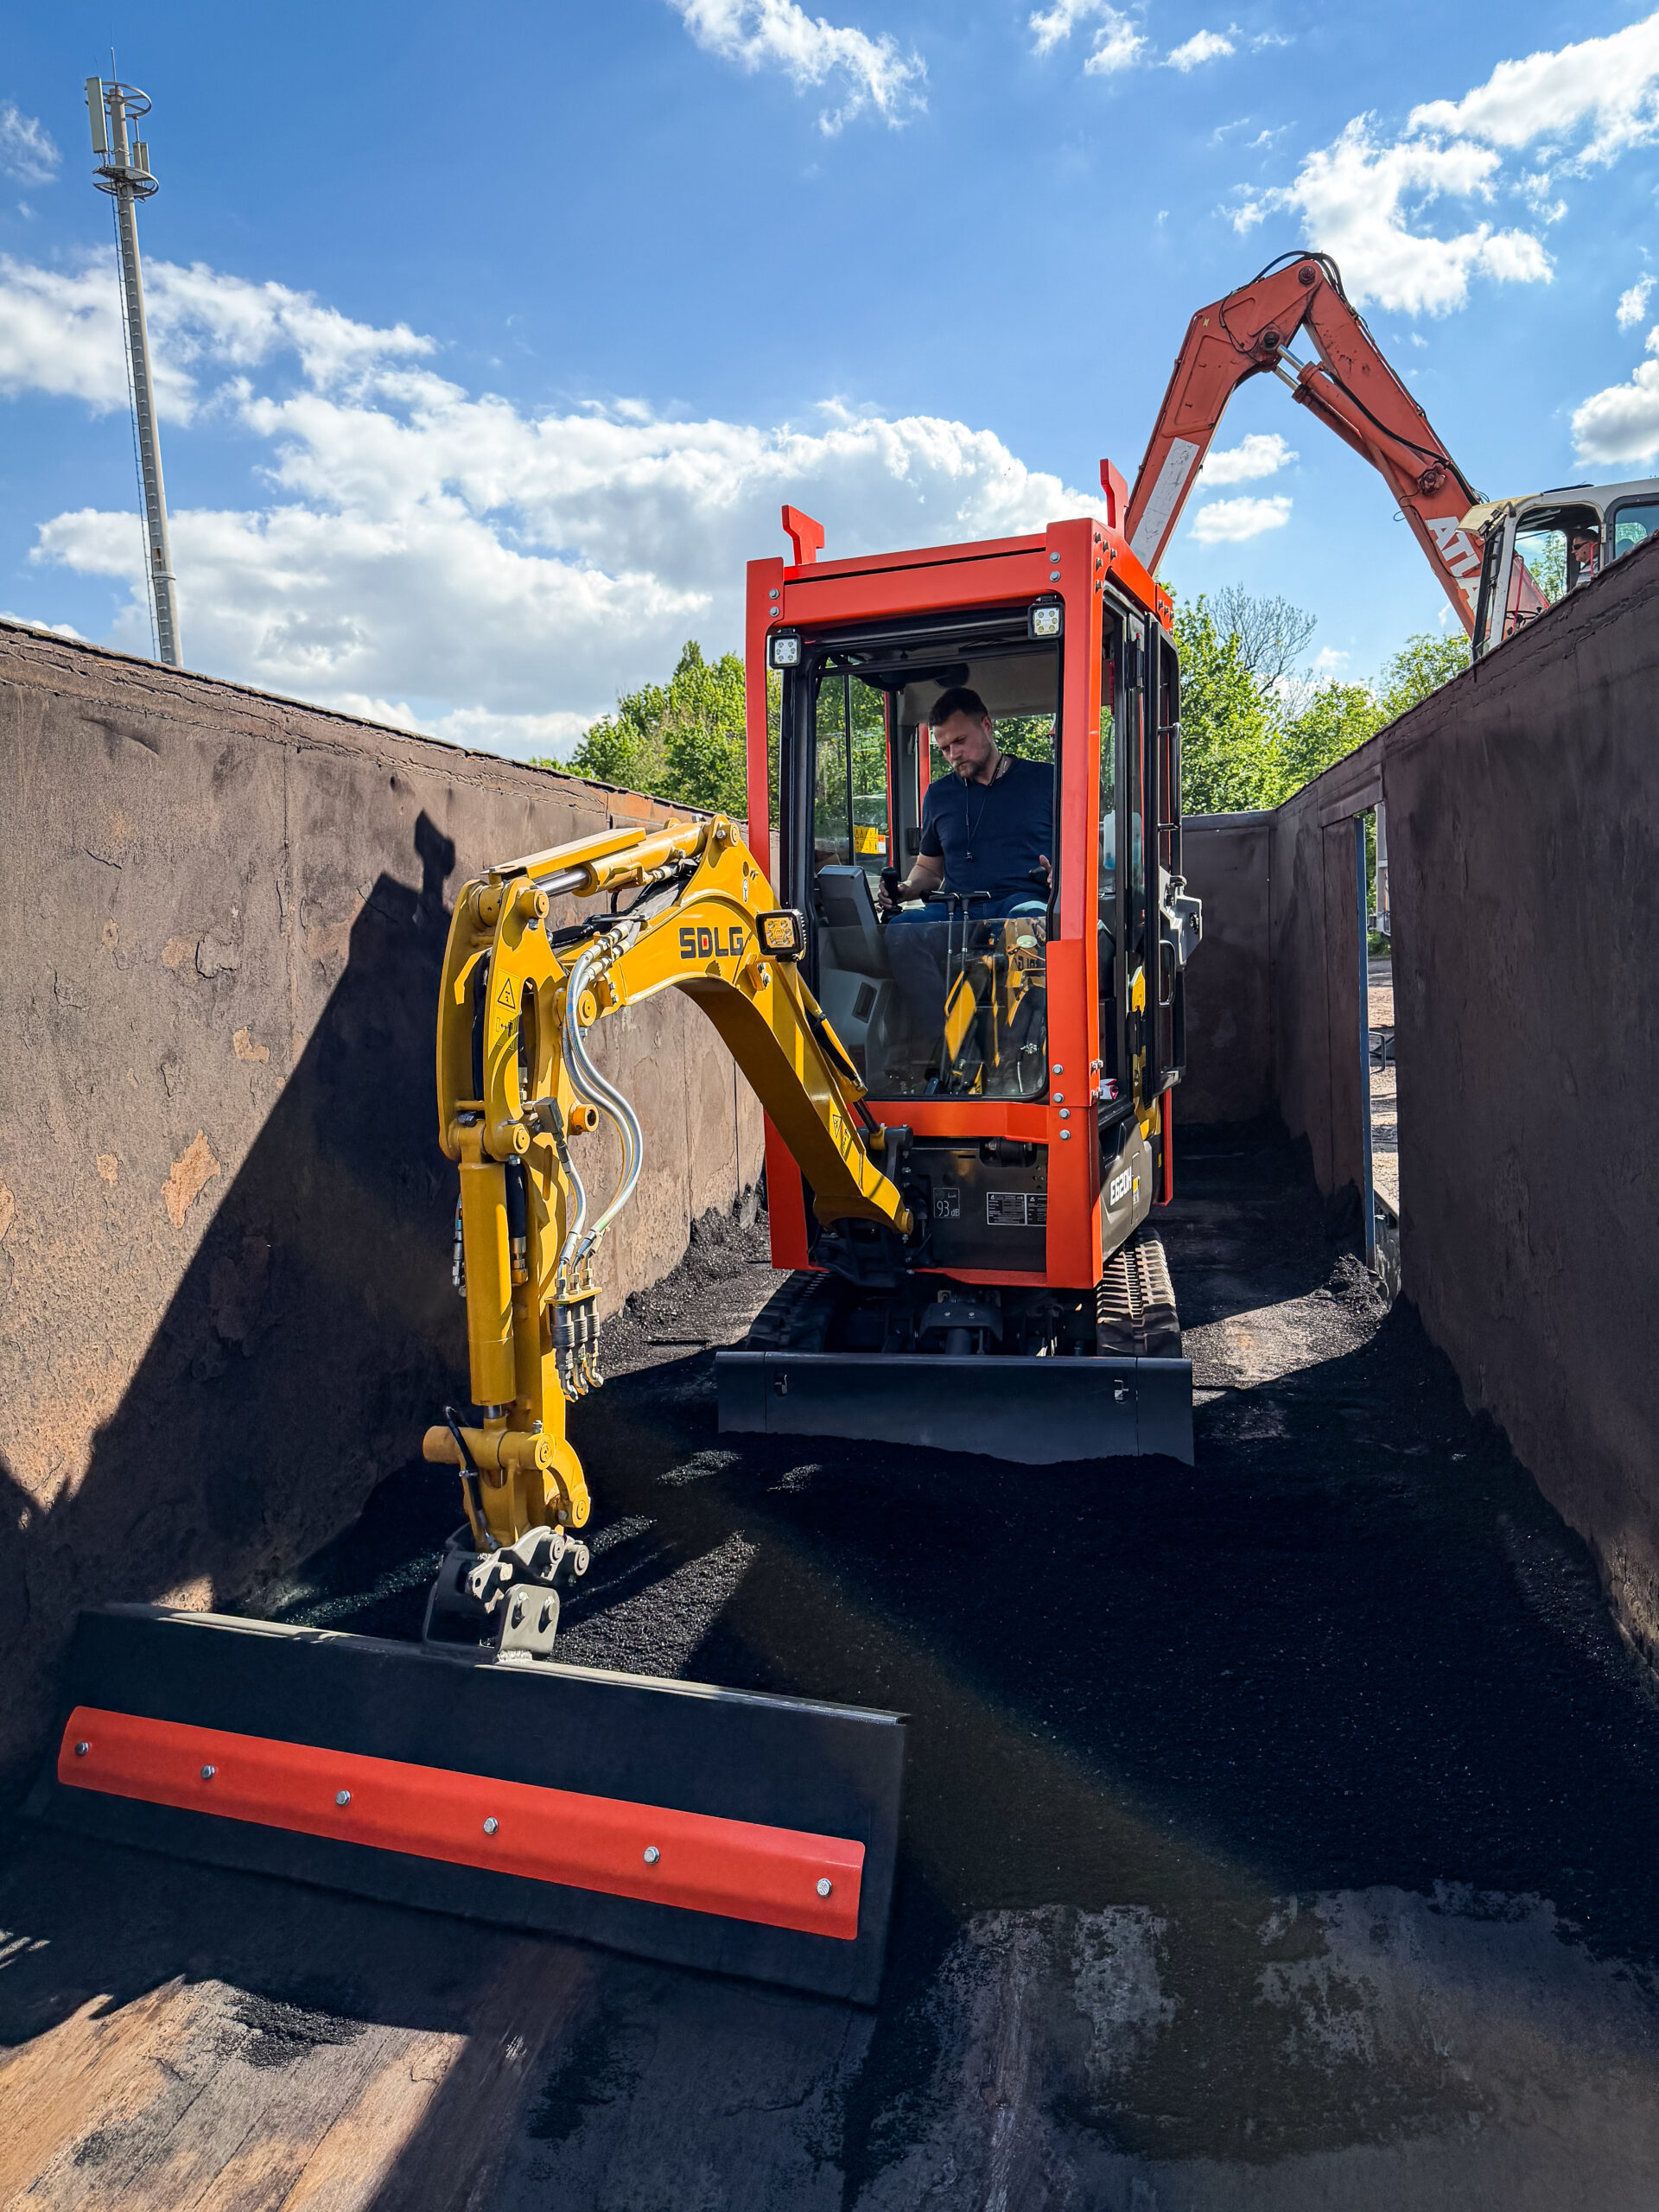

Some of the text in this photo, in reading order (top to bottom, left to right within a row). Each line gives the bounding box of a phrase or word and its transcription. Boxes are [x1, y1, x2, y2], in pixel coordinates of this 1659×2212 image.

[678, 926, 744, 959] SDLG
[937, 1200, 961, 1217] 93 dB
